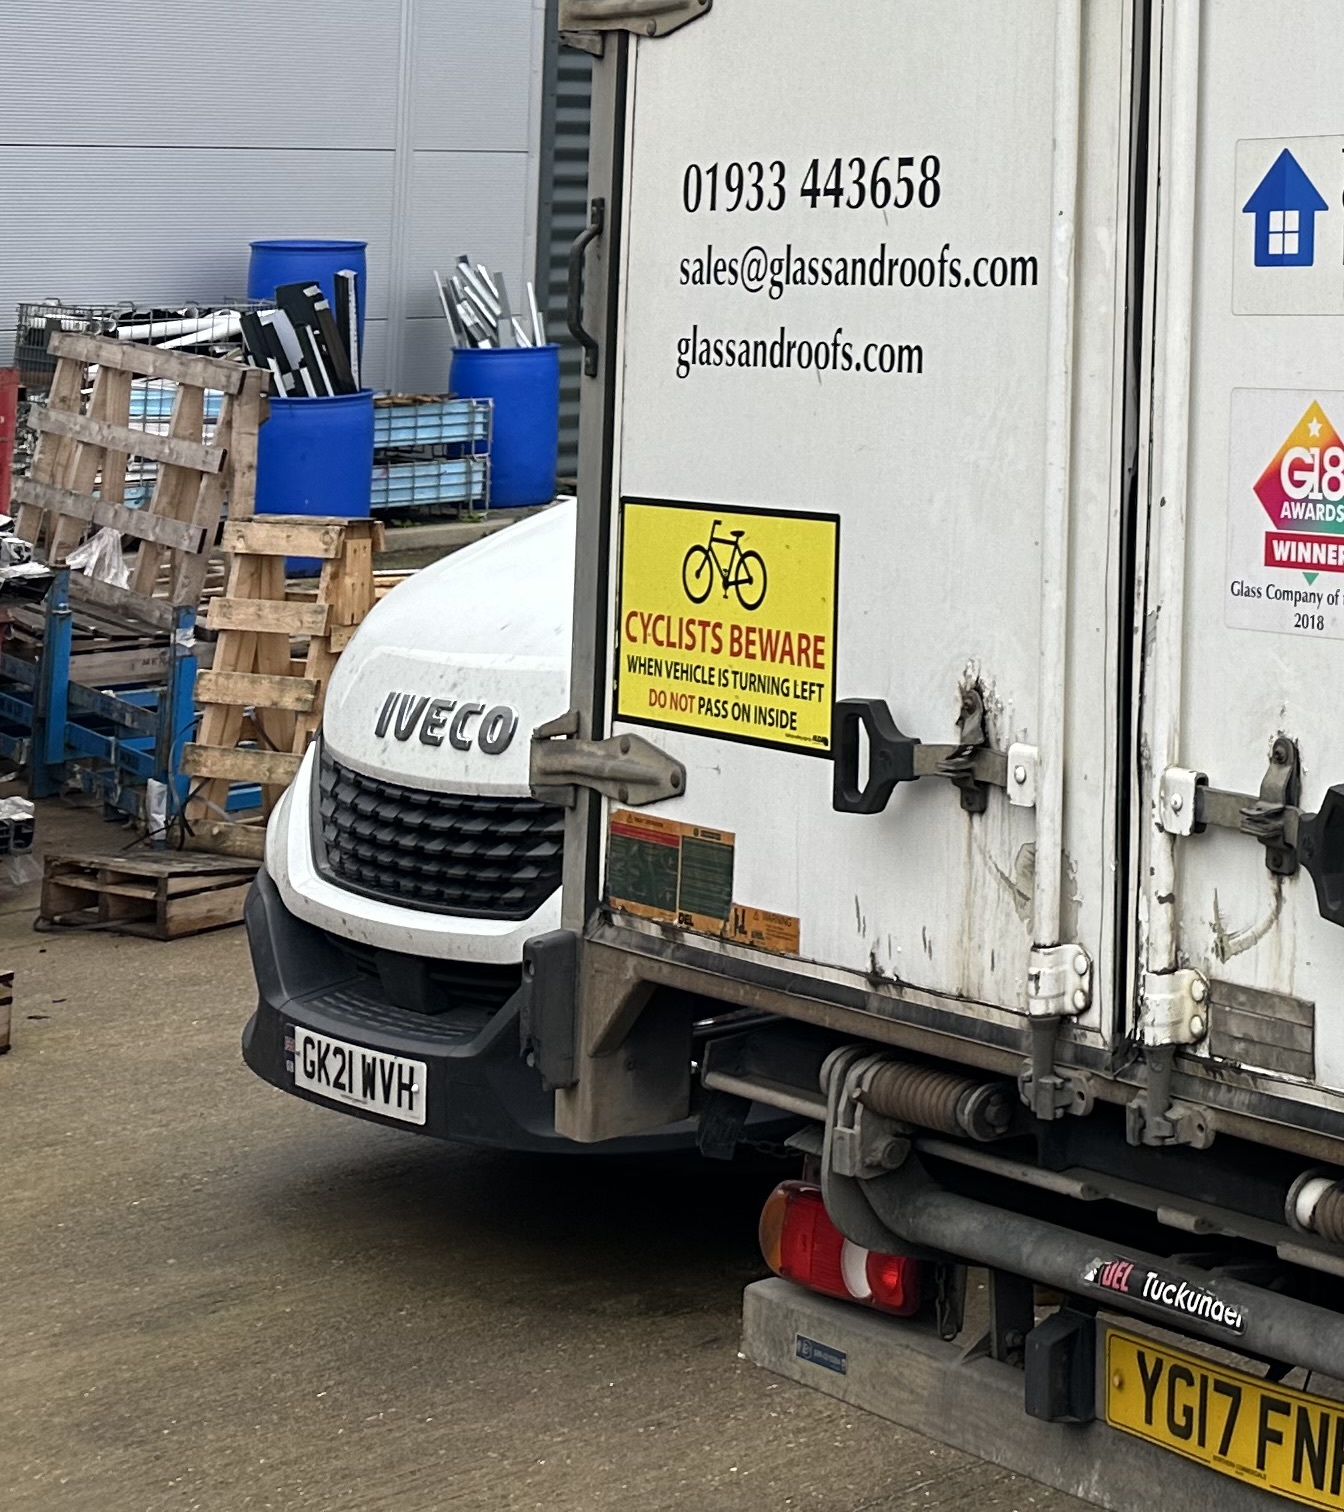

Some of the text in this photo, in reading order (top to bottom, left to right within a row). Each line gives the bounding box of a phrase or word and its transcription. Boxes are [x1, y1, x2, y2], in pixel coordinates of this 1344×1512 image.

[683, 155, 941, 212] 01933 443658
[680, 243, 1038, 299] sales@glassandroofs.com
[676, 325, 923, 379] glassandroofs.com
[1280, 501, 1344, 522] AWARDS
[1230, 580, 1262, 599] Glass
[1266, 583, 1323, 610] Company
[1326, 589, 1341, 606] of
[1294, 613, 1325, 630] 2018
[625, 610, 825, 670] CYCLISTS BEWARE
[626, 654, 824, 703] WHEN VEHICLE IS TURNING LEFT
[375, 692, 519, 755] IVECO
[649, 688, 797, 731] DO NOT PASS ON INSIDE
[303, 1036, 414, 1110] GK21 WVH
[1137, 1350, 1242, 1456] YG17
